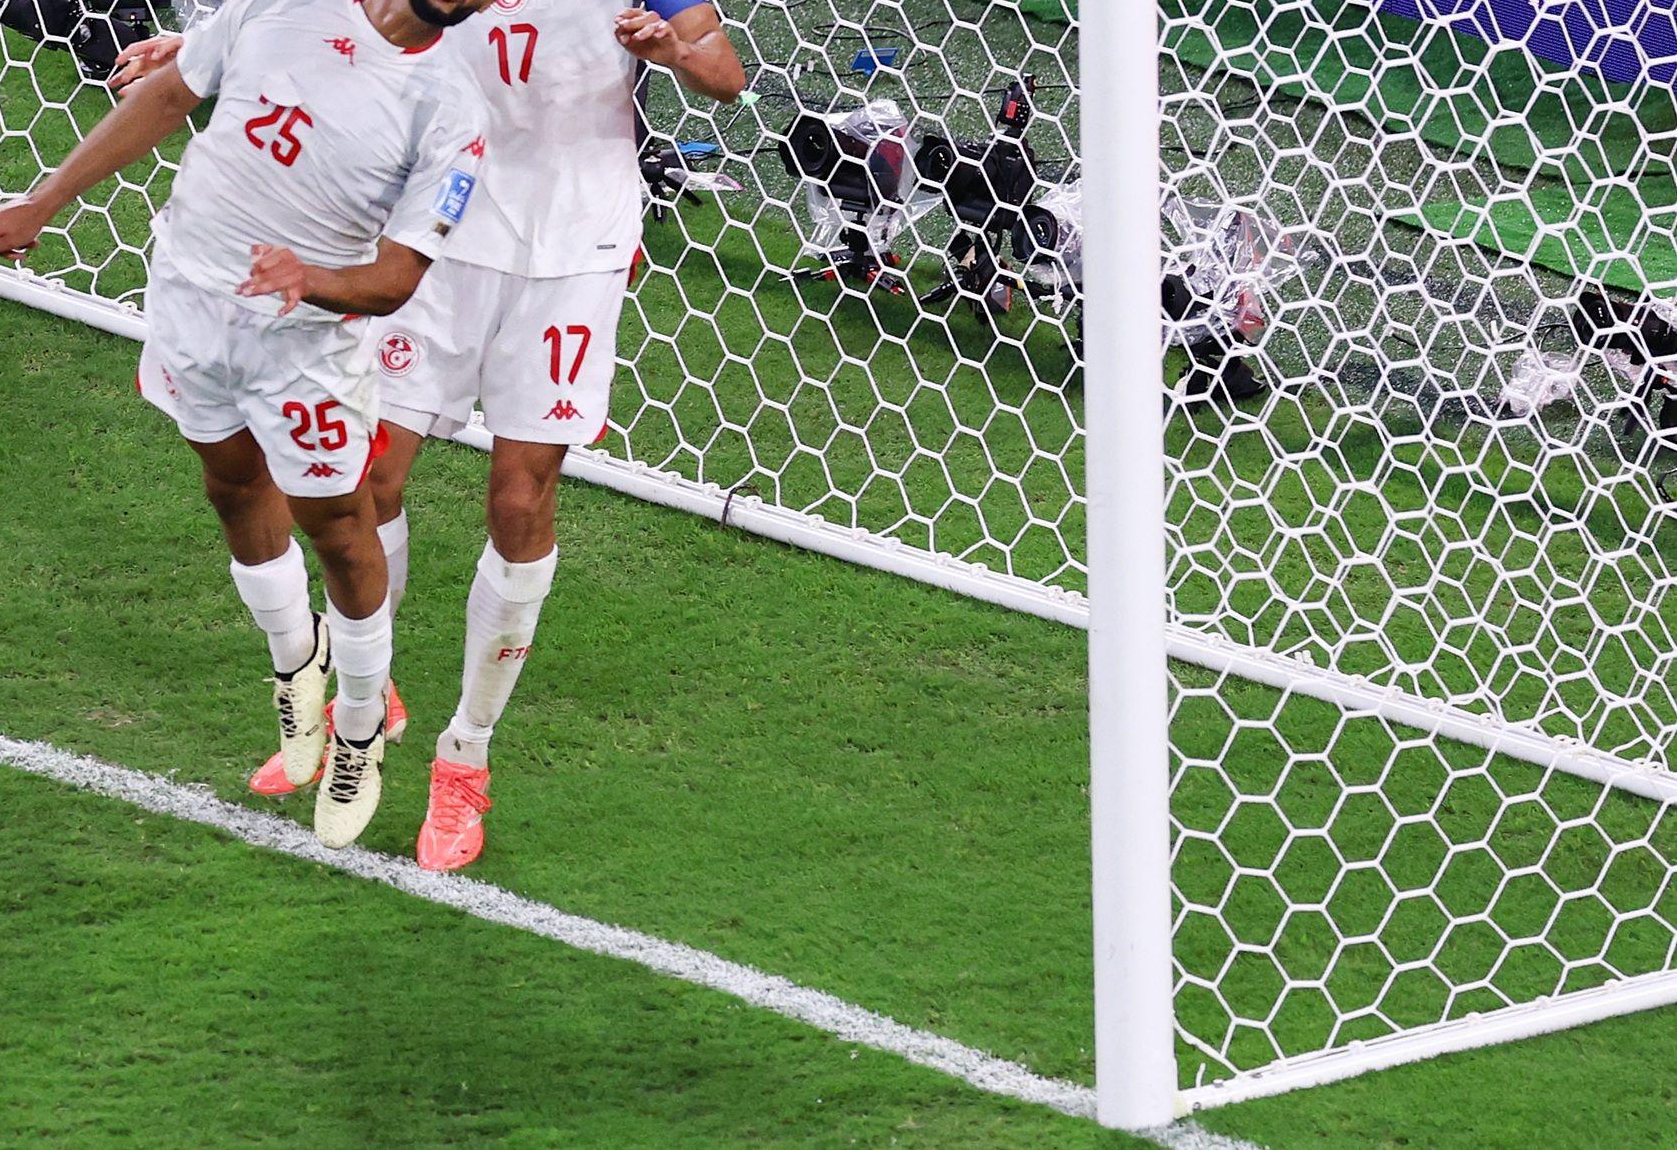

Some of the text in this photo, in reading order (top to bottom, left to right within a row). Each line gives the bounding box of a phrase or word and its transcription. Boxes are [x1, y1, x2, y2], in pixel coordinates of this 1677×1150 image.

[488, 23, 539, 87] 17
[245, 94, 314, 167] 25
[543, 325, 591, 386] 17
[282, 400, 348, 451] 25
